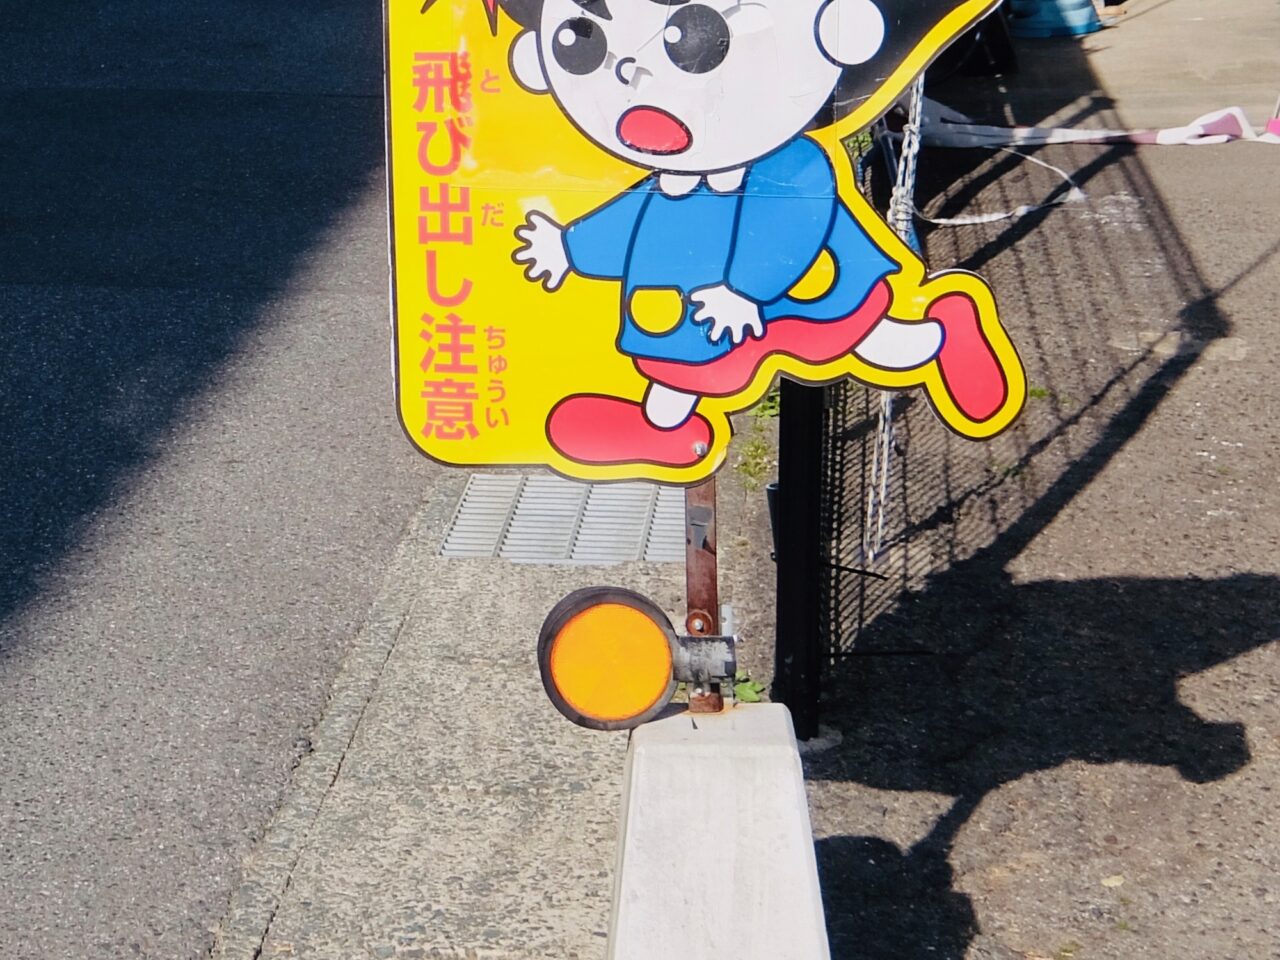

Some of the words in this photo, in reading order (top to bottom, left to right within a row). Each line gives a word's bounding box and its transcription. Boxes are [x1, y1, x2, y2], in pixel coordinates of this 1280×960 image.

[479, 69, 501, 94] と
[412, 51, 480, 440] 飛び出し注意
[480, 201, 505, 228] だ
[483, 325, 509, 429] ちゅうい
